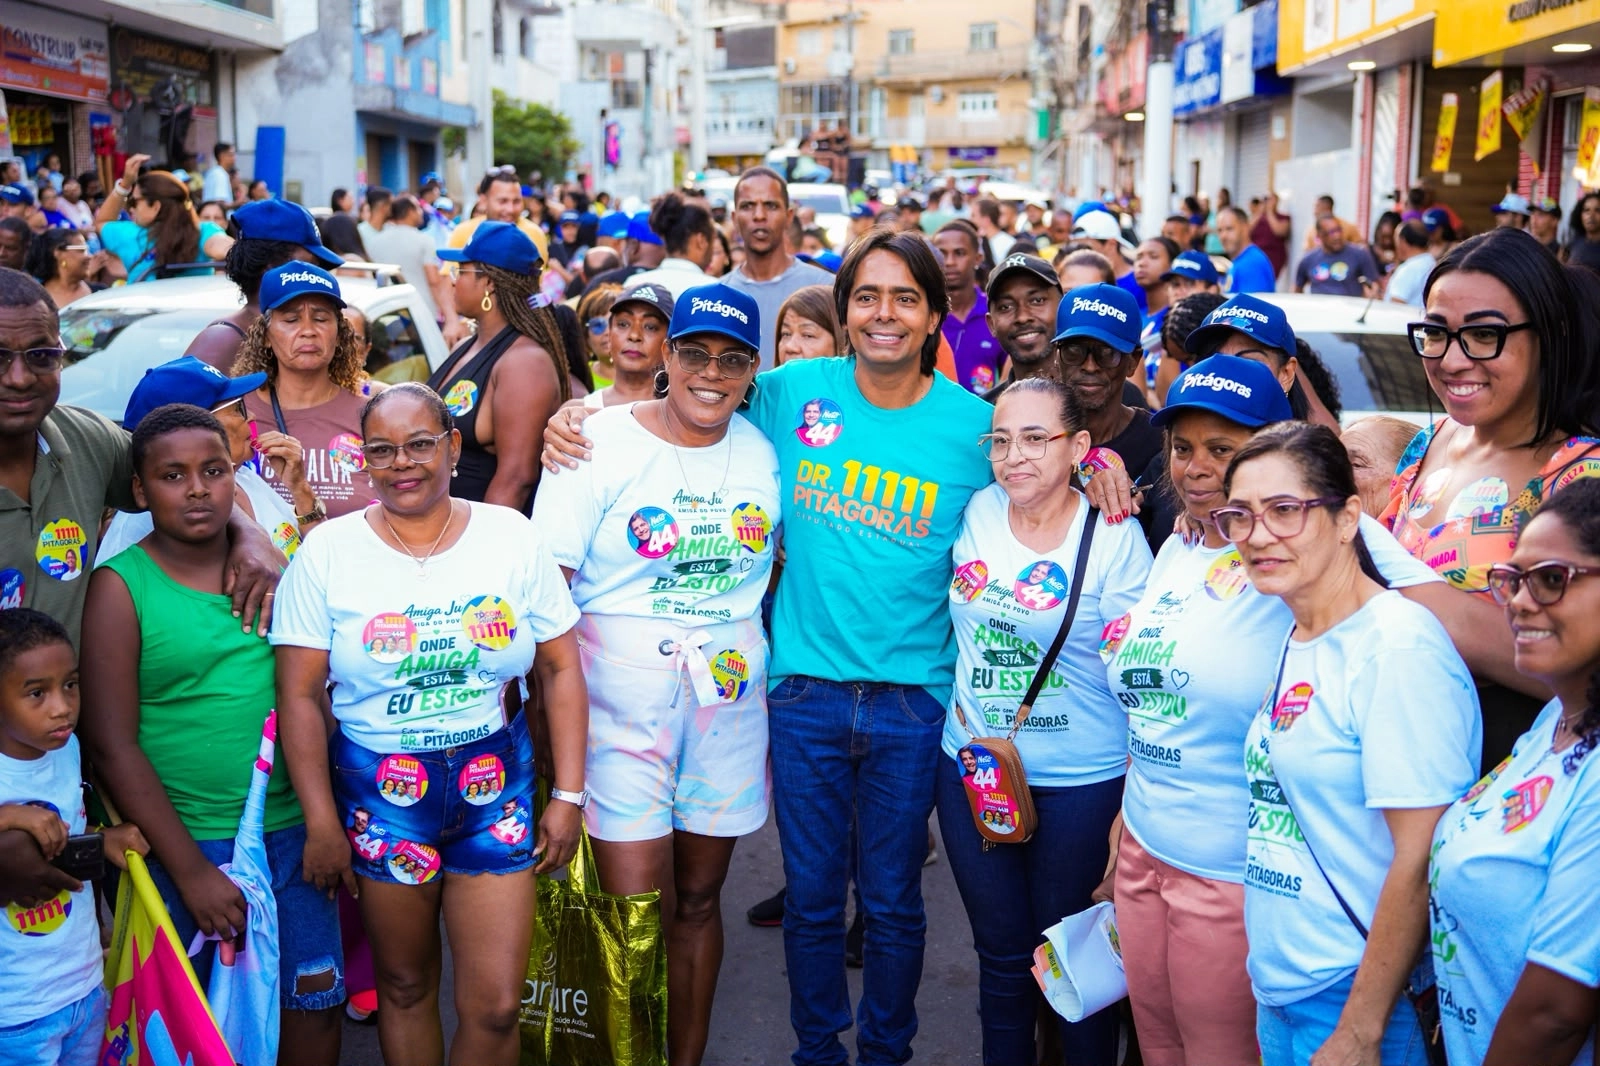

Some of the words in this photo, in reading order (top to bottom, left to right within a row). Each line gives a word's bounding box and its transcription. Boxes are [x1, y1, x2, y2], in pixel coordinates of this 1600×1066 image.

[691, 300, 748, 325] Pitágoras
[1071, 299, 1127, 323] Pitágoras
[1180, 373, 1252, 399] Pitágoras
[805, 422, 837, 445] 44
[797, 459, 835, 491] DR.
[842, 460, 939, 519] 11111
[794, 484, 932, 538] PITÁGORAS
[55, 527, 79, 540] 11111
[647, 524, 677, 553] 44
[691, 523, 722, 536] ONDE
[667, 536, 743, 562] AMIGA
[689, 561, 719, 573] ESTÁ,
[1021, 583, 1057, 610] 44
[402, 603, 442, 620] Amiga
[444, 601, 462, 616] Ju
[468, 621, 509, 639] 11111
[989, 618, 1017, 635] ONDE
[419, 637, 456, 652] ONDE
[974, 624, 1039, 657] AMIGA
[394, 646, 481, 680] AMIGA
[1116, 639, 1178, 667] AMIGA
[423, 673, 455, 687] ESTÁ,
[971, 667, 994, 689] EU
[1000, 669, 1070, 692] ESTU.
[1131, 670, 1155, 688] ESTÁ,
[386, 693, 416, 716] EU
[984, 713, 1003, 726] DR.
[400, 734, 421, 747] DR.
[423, 724, 491, 747] PITÁGORAS
[398, 758, 419, 769] 11111
[478, 757, 497, 768] 11111
[972, 767, 997, 790] 44
[495, 815, 526, 844] 44
[354, 832, 384, 859] 44
[15, 898, 64, 930] 11111
